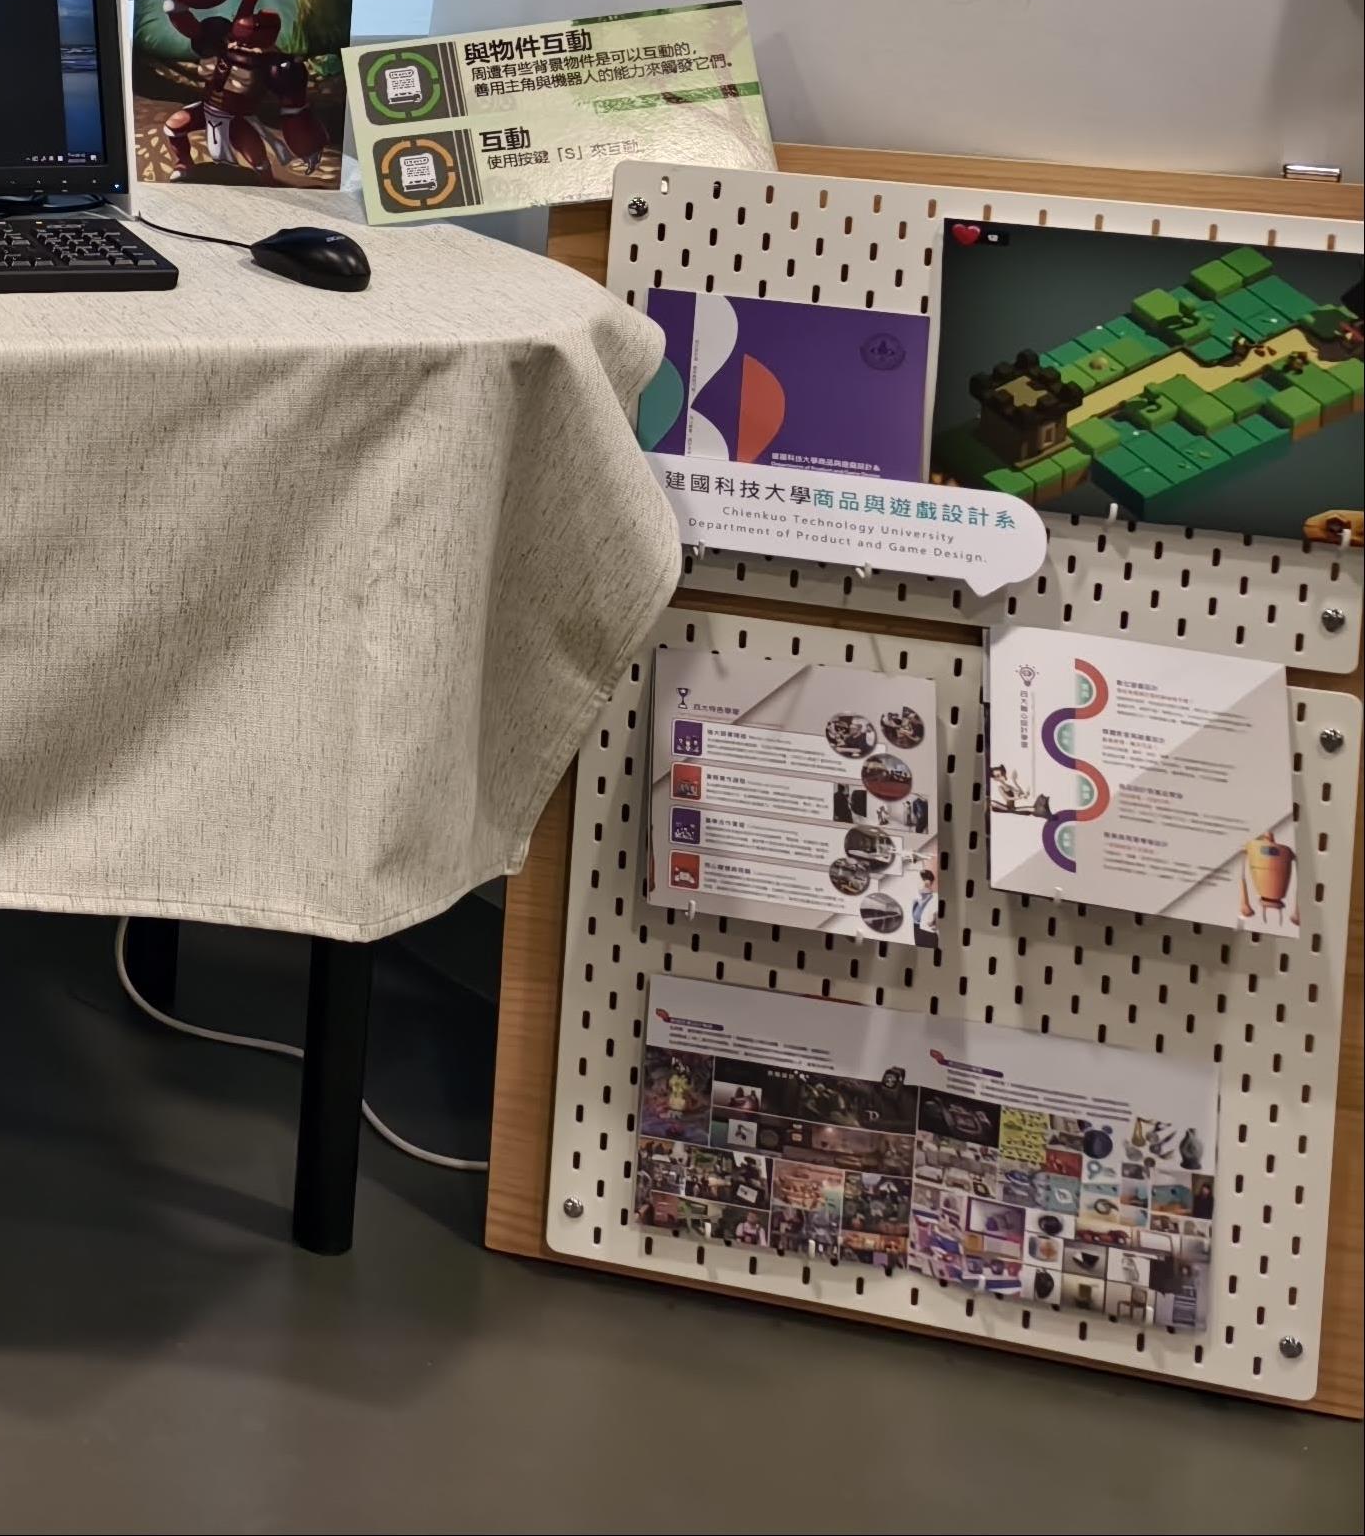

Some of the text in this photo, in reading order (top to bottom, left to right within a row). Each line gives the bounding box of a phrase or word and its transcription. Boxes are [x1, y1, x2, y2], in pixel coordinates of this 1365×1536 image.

[464, 28, 592, 65] 與物件互動
[479, 126, 531, 153] 互動
[665, 471, 1016, 530] 建國科技大學商品與遊戲設計系
[688, 517, 988, 563] Department of Product and Game Design.
[722, 506, 955, 545] Chienkuo Technology University
